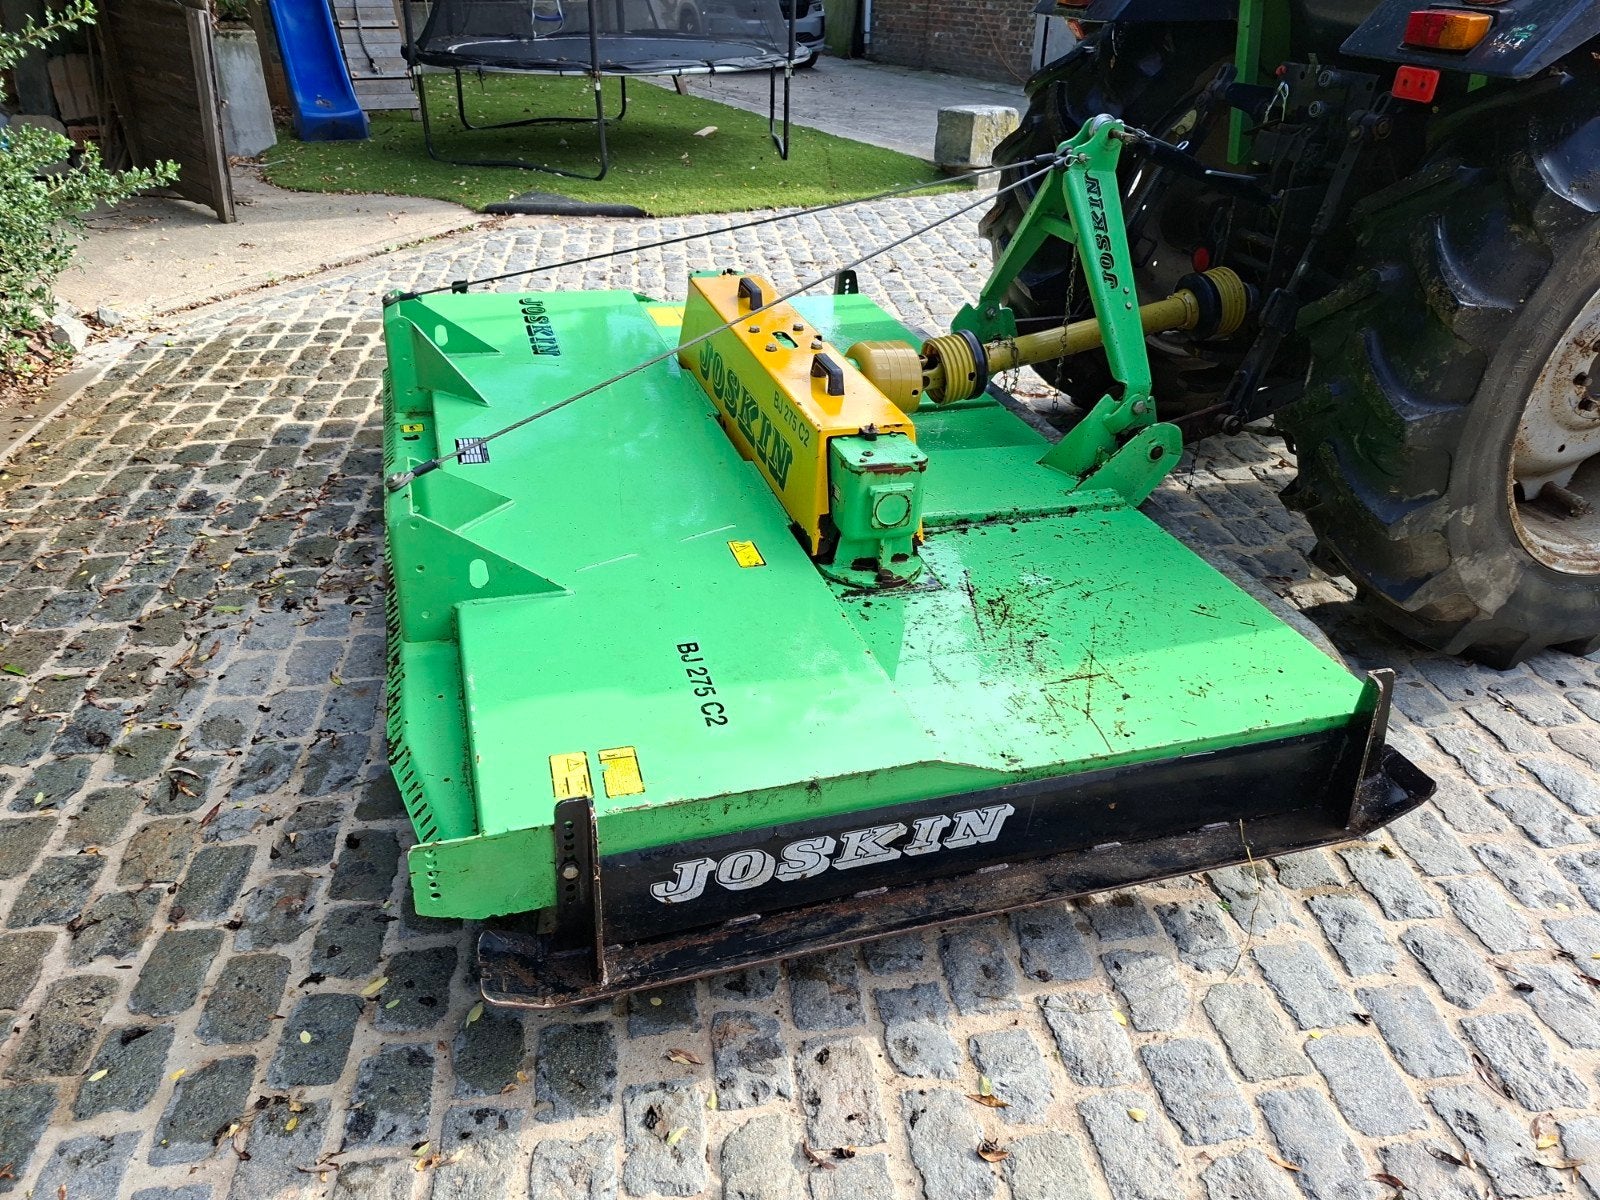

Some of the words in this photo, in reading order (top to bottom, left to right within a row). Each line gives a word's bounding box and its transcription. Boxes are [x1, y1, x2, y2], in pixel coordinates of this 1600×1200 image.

[1084, 168, 1118, 289] JOSKIN
[519, 298, 561, 356] JOSKIN
[700, 339, 793, 492] JOSKIN
[773, 390, 784, 415] BJ
[783, 406, 798, 432] 275
[798, 422, 810, 447] C2
[677, 642, 704, 662] BJ
[686, 667, 717, 697] 275
[700, 702, 728, 727] C2
[650, 802, 1016, 904] JOSKIN
